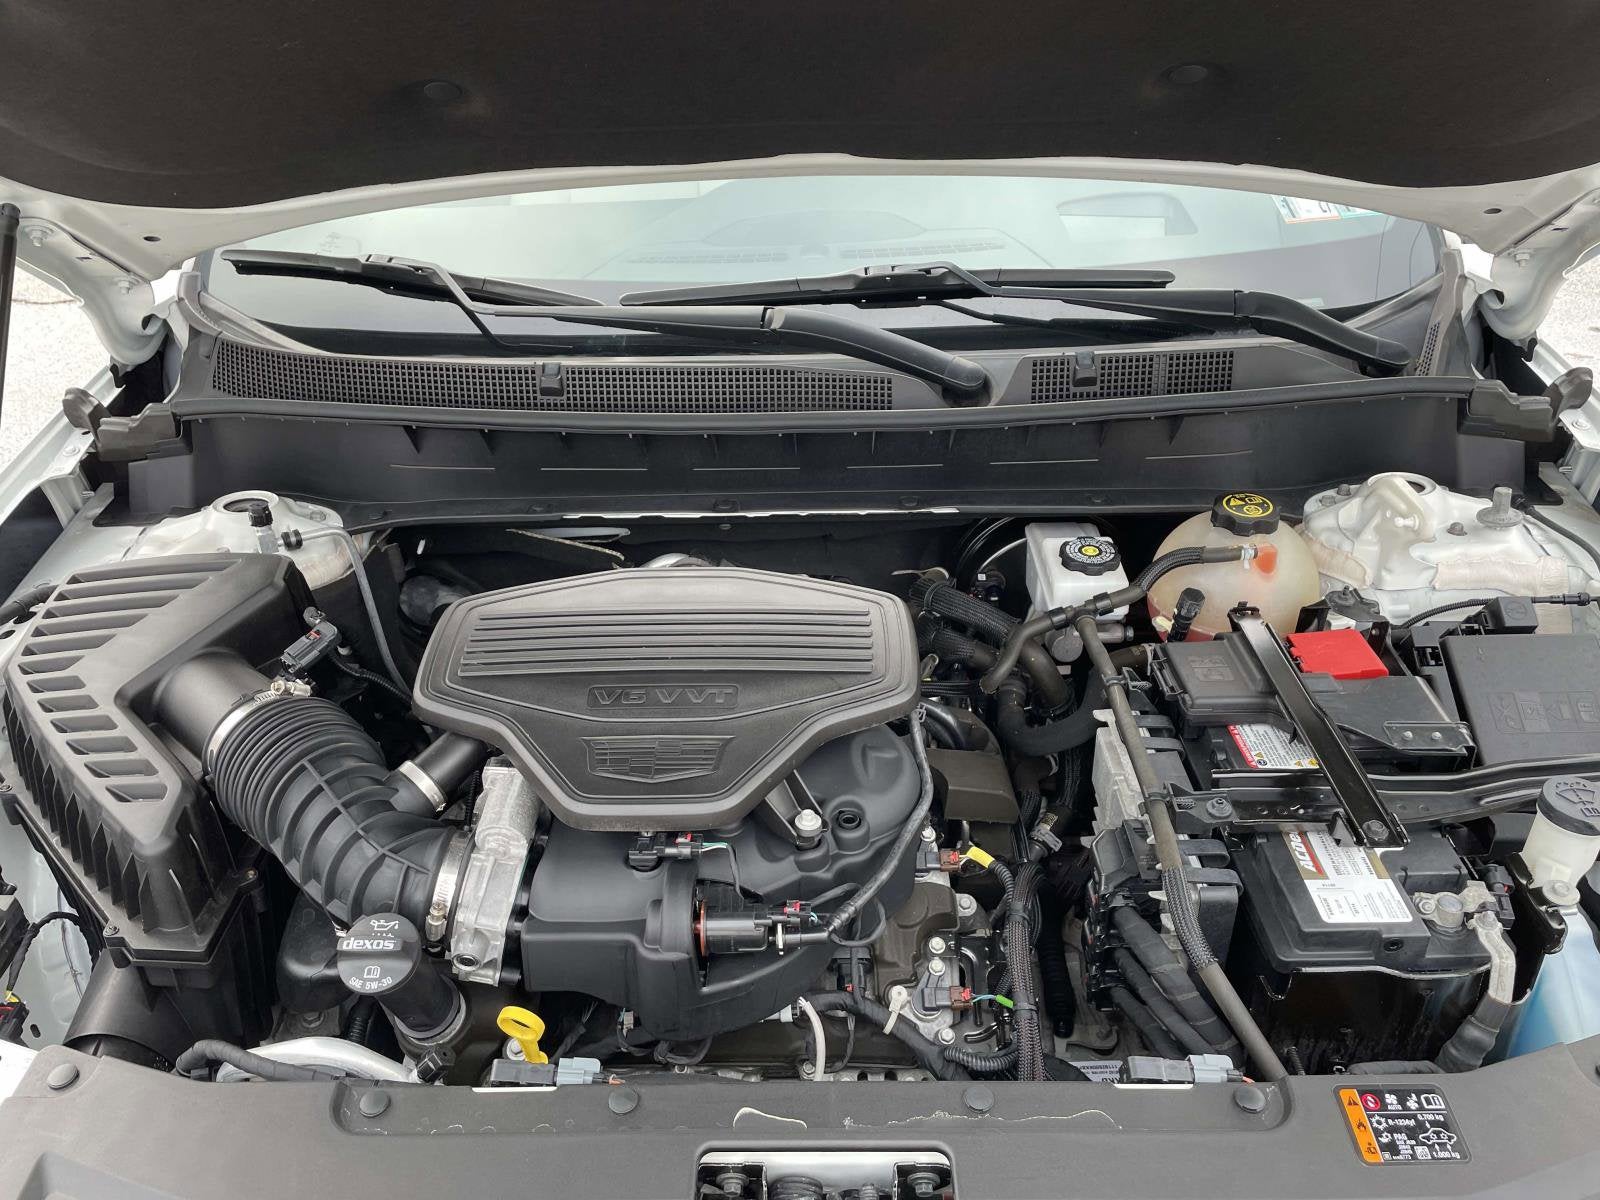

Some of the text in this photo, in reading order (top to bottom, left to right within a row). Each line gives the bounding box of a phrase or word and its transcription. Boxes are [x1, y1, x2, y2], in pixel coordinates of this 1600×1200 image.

[594, 687, 734, 705] V6 VVT
[342, 937, 395, 950] dexos
[349, 976, 393, 990] SAE 5W-30
[1434, 1113, 1445, 1122] kg
